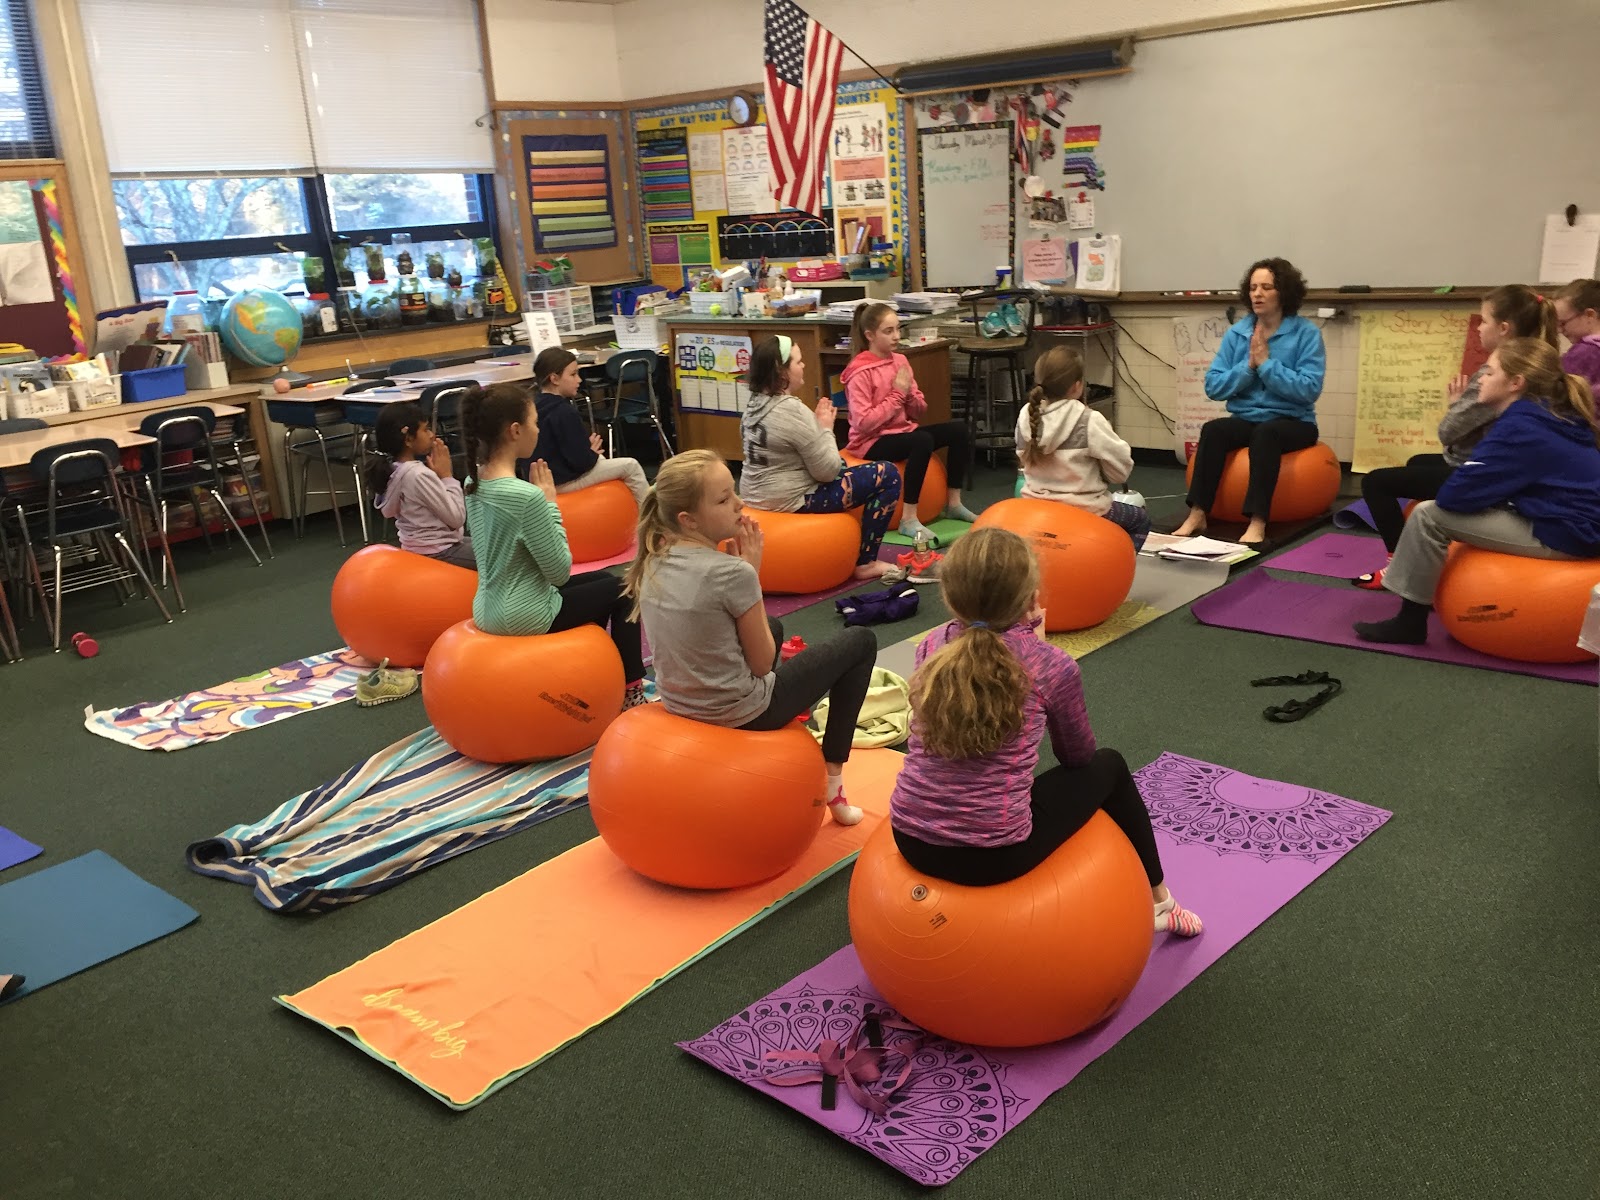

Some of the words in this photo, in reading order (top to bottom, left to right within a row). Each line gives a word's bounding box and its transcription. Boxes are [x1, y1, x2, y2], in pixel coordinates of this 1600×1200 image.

[699, 112, 716, 122] YOU
[837, 92, 878, 106] OUNTS!
[888, 112, 899, 249] VOCABULARY
[1394, 309, 1431, 334] Story
[695, 336, 714, 344] ZONES
[361, 988, 439, 1031] dream
[430, 1021, 467, 1059] big
